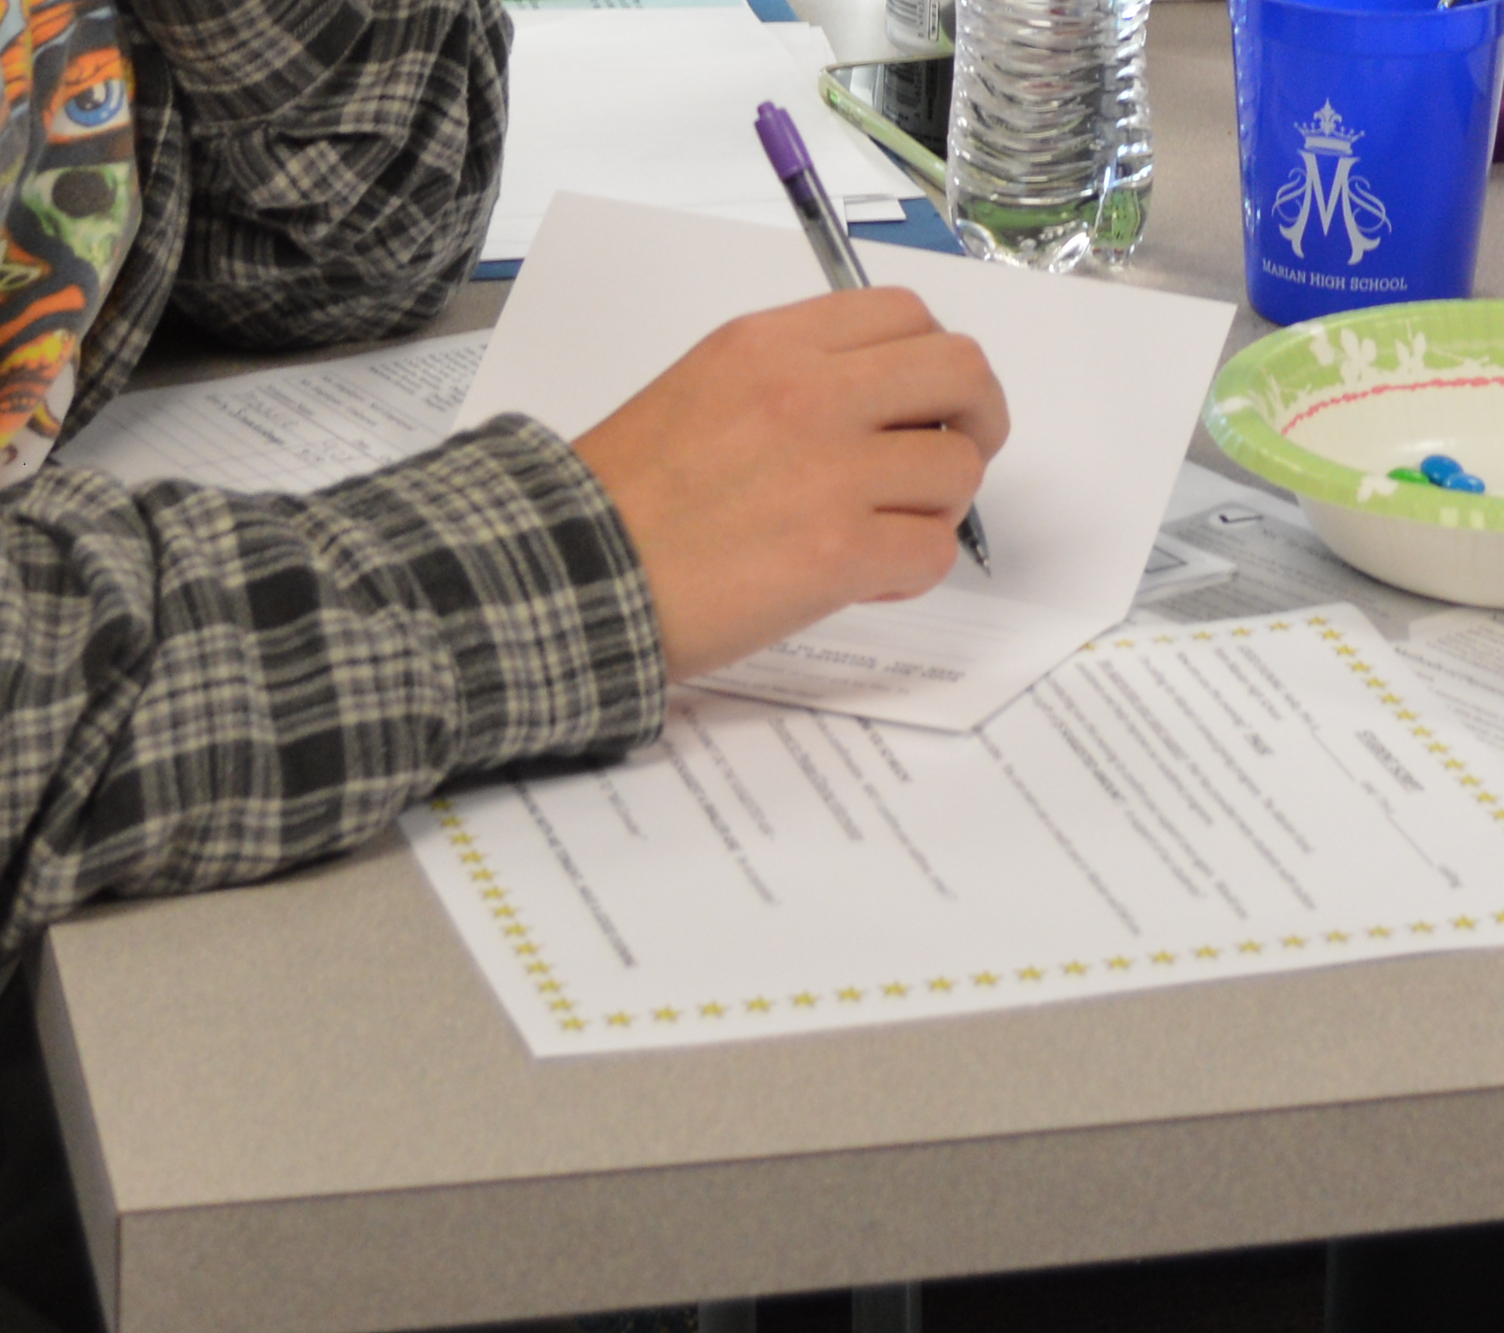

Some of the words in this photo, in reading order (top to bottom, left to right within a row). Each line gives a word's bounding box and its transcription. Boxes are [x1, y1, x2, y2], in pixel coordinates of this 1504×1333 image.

[1262, 258, 1306, 284] MARIAN
[1310, 272, 1346, 290] HIGH
[1350, 277, 1408, 292] SCHOOL
